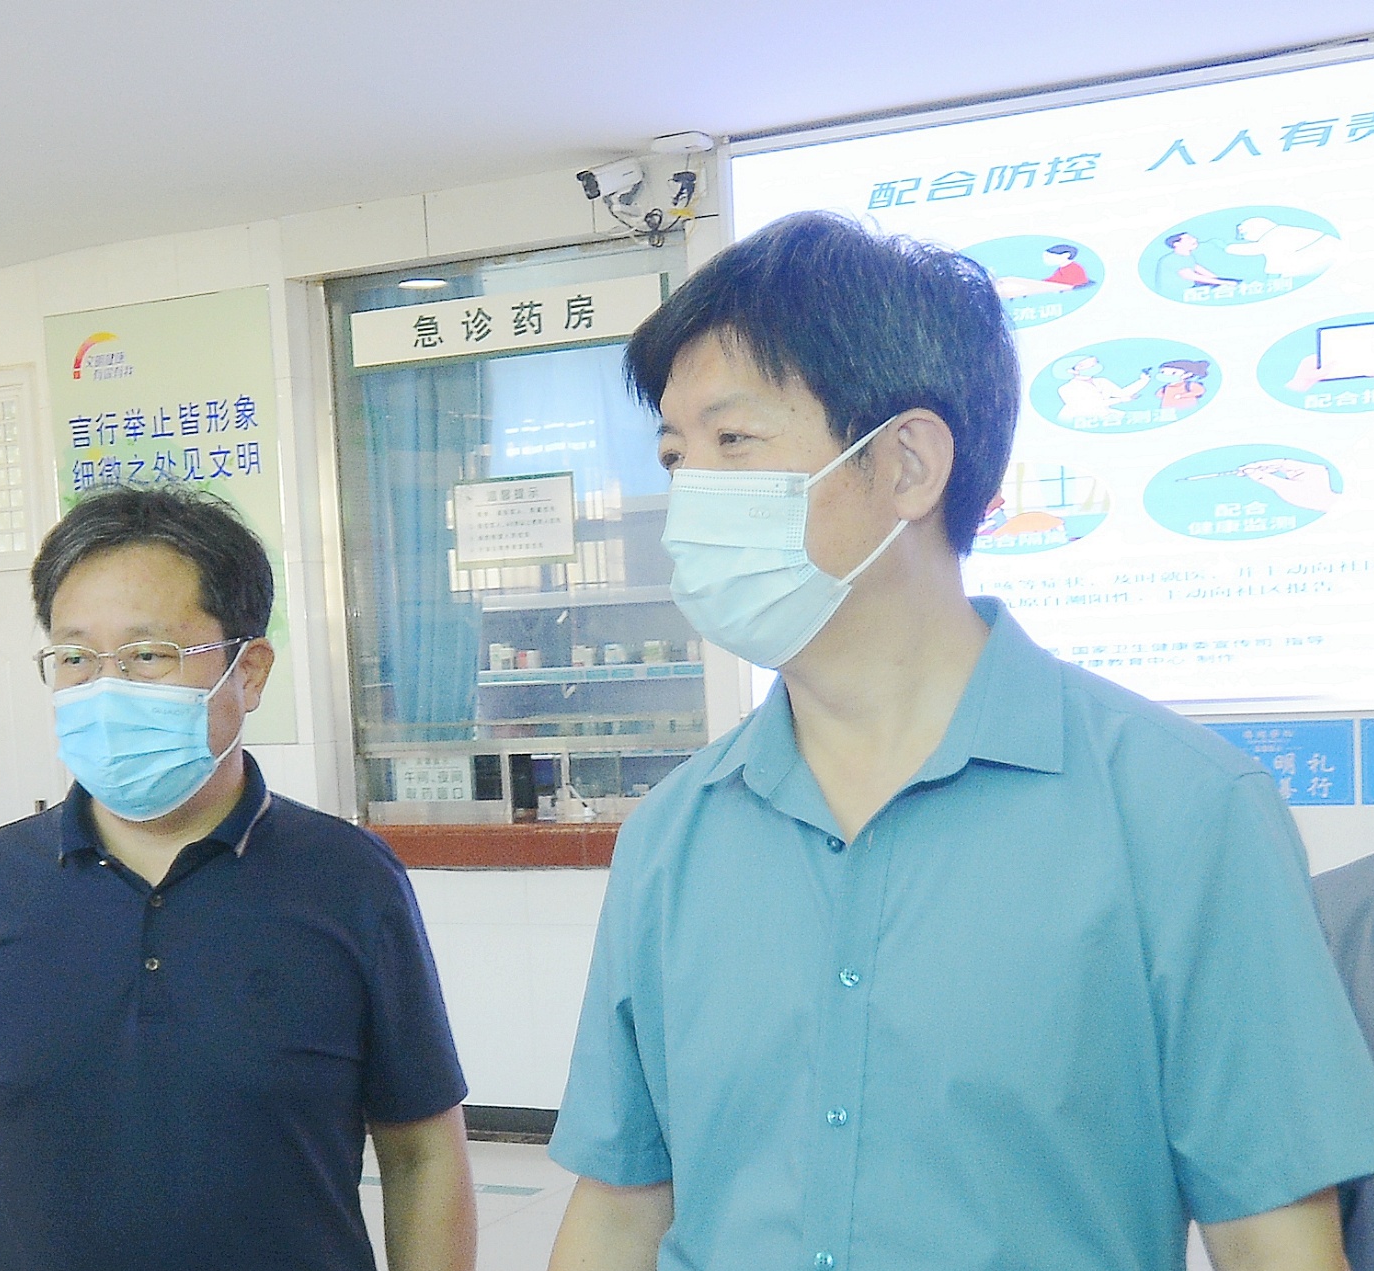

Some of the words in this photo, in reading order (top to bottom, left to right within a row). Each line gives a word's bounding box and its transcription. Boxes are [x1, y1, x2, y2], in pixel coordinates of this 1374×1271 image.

[866, 151, 1102, 210] 配合防控
[1182, 276, 1295, 304] 配合检测
[412, 294, 595, 349] 急诊药房
[1009, 303, 1063, 322] 流调
[68, 393, 258, 448] 言行举止皆形象
[72, 441, 262, 491] 细微之处见文明
[1215, 501, 1268, 518] 配合
[1188, 515, 1299, 537] 健康监测
[1253, 751, 1335, 775] 明礼
